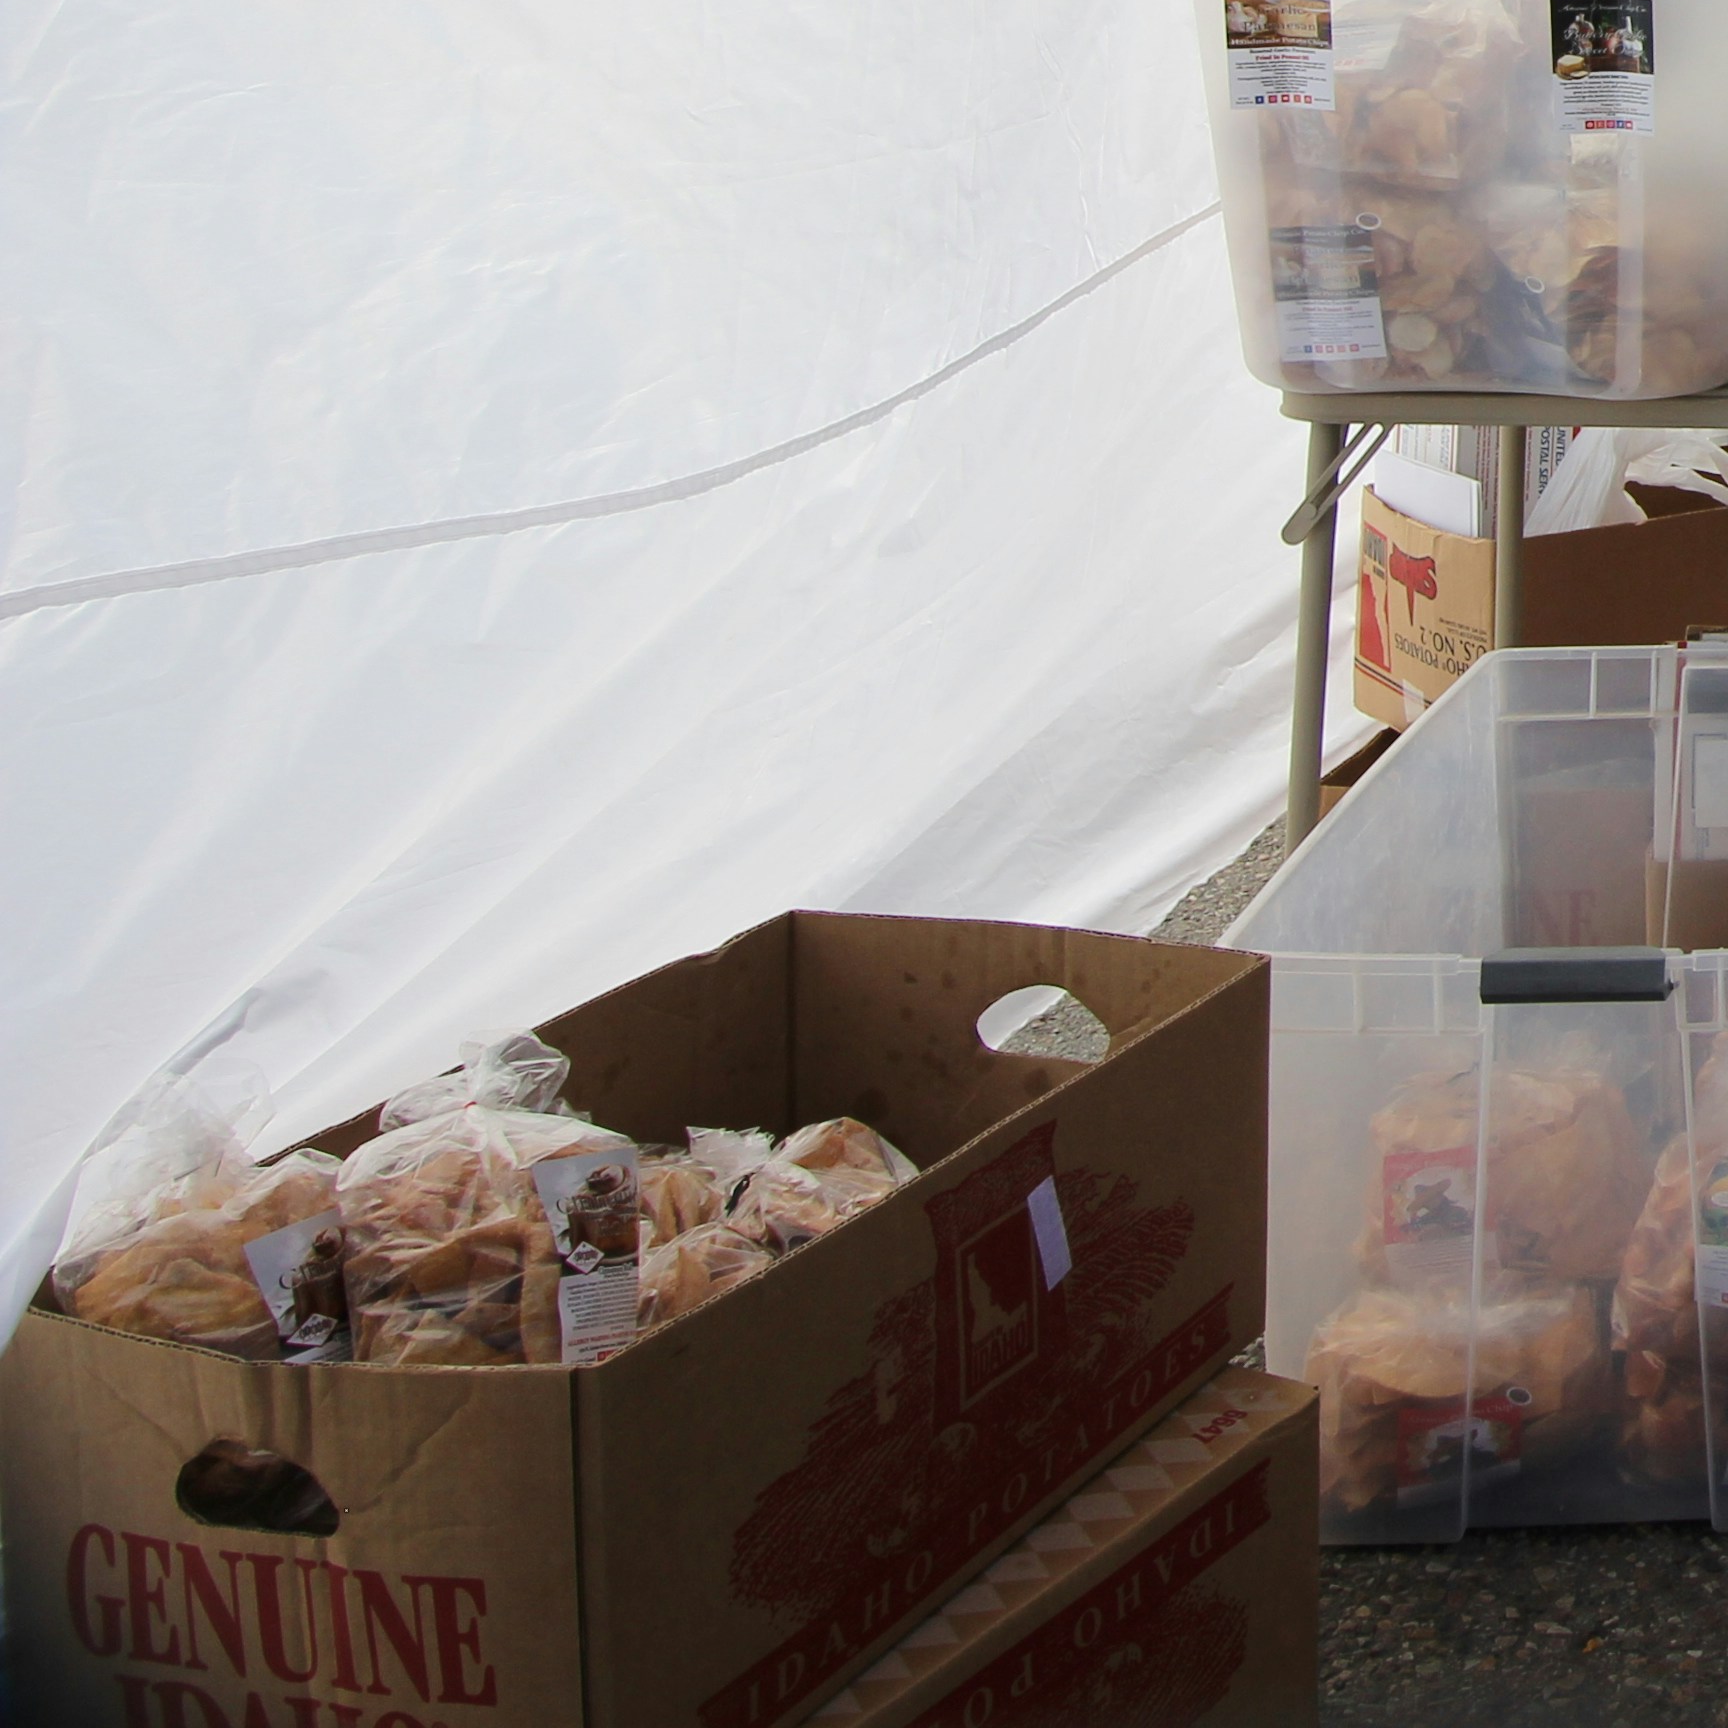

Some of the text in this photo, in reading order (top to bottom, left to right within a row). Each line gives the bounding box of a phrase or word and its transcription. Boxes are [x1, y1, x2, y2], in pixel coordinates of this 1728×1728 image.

[1394, 632, 1439, 668] POTATOES
[1419, 625, 1427, 645] 2
[1428, 629, 1456, 656] NO.
[971, 1320, 1030, 1376] IDAHO
[744, 1319, 1208, 1724] IDAHO POTATOES
[1073, 1501, 1236, 1649] IDAHO
[66, 1523, 498, 1707] GENUINE
